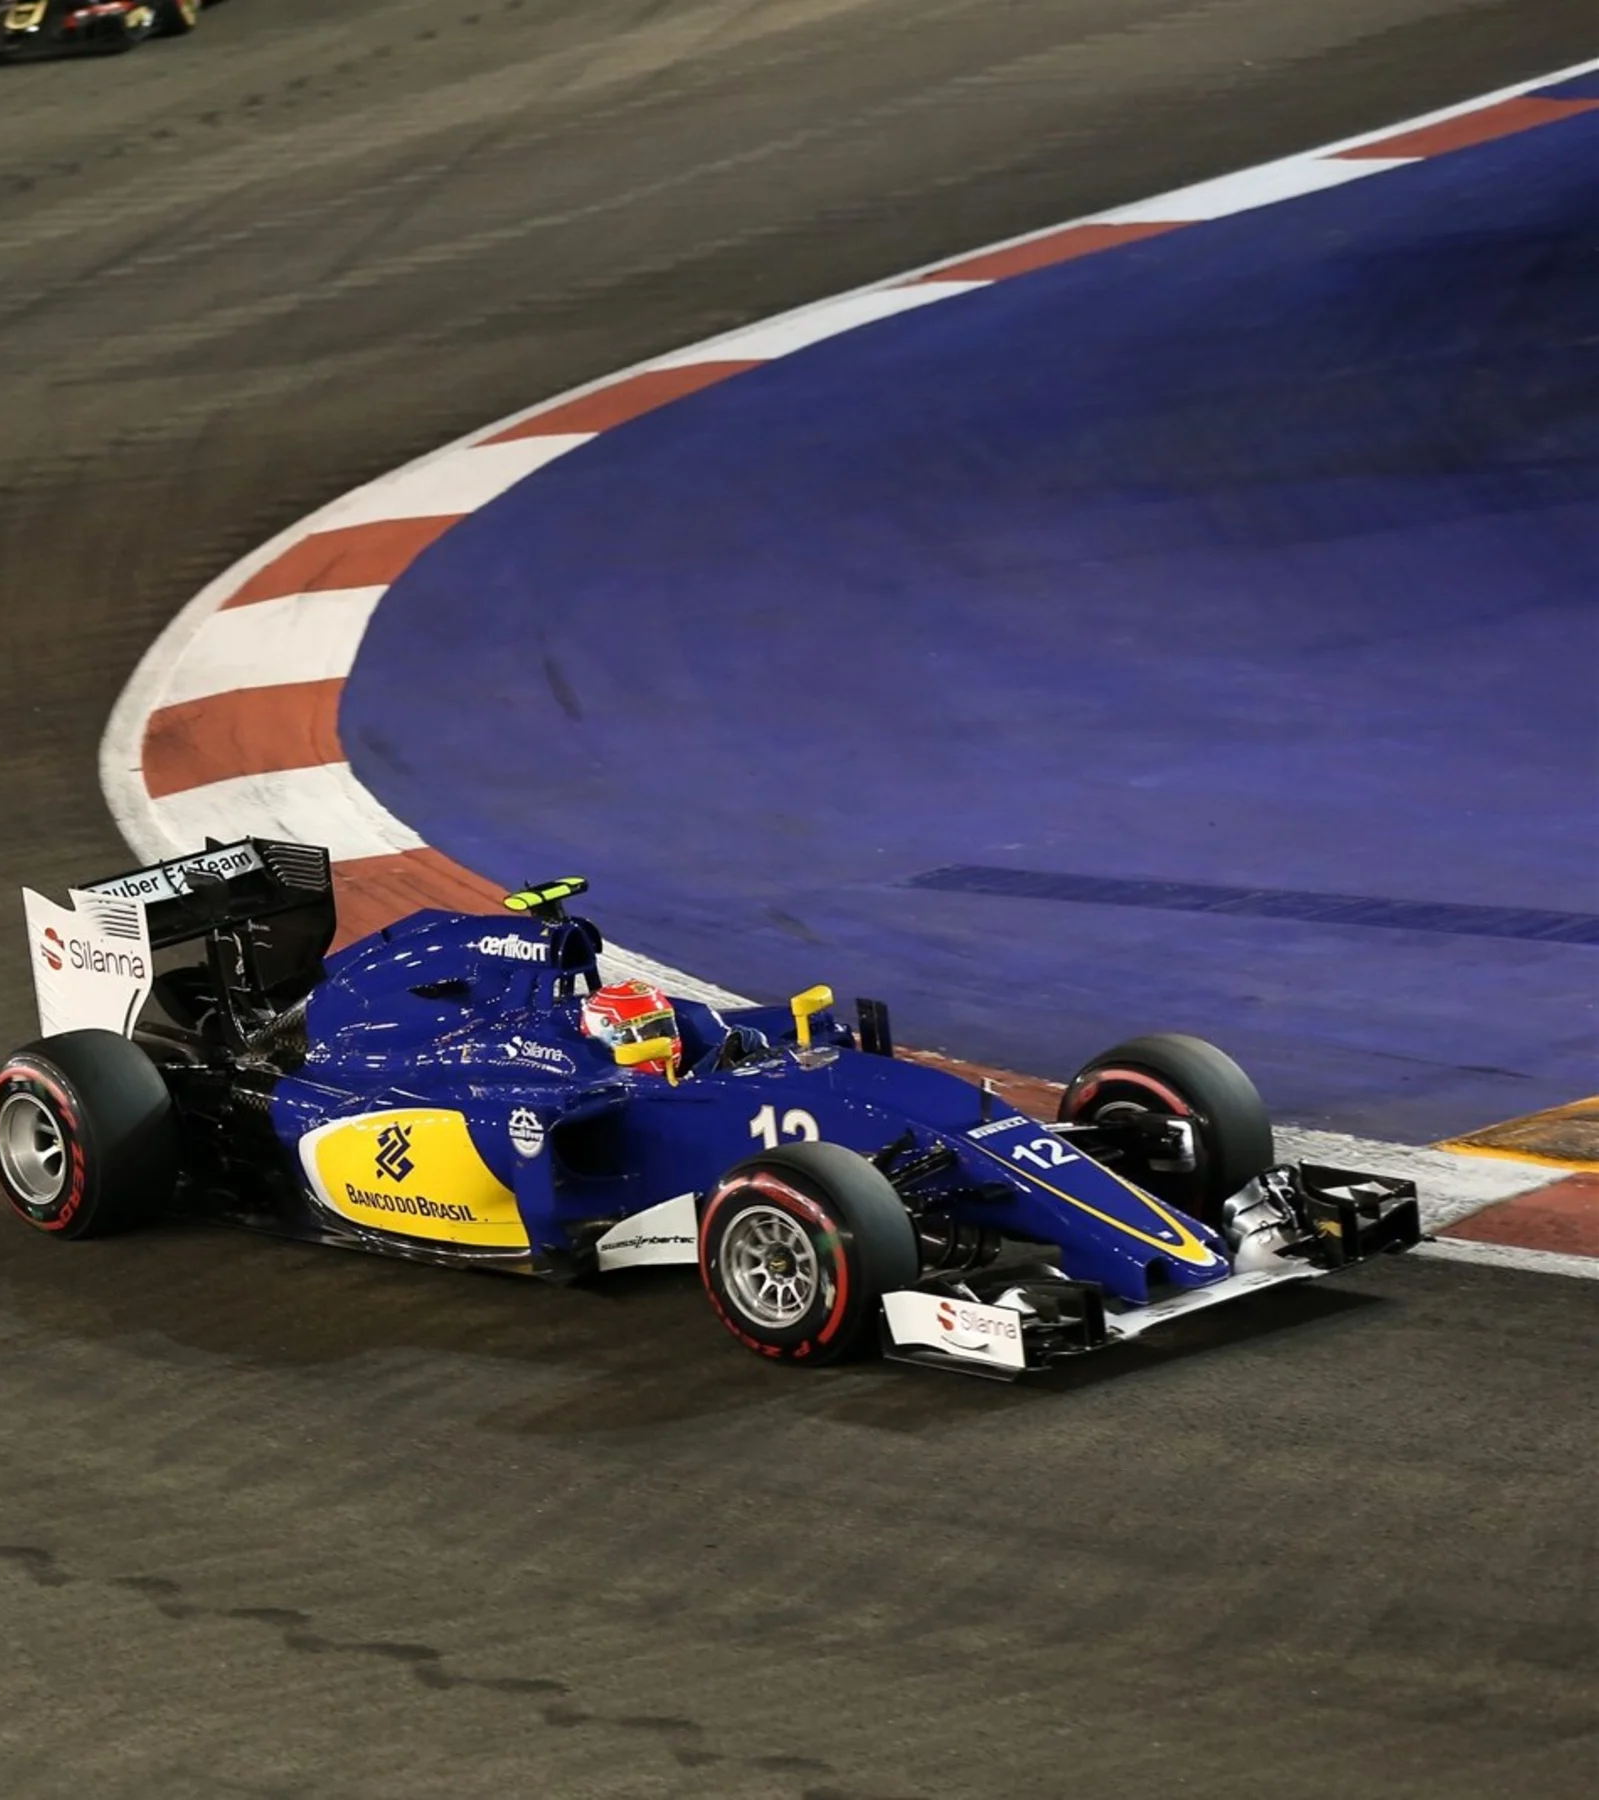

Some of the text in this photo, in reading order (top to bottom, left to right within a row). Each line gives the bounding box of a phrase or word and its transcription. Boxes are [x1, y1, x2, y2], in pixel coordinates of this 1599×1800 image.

[193, 850, 253, 873] Team
[69, 939, 146, 979] Silanna
[521, 1040, 563, 1061] Silanna
[1012, 1138, 1080, 1169] 12
[345, 1183, 477, 1222] BANCO DO BRASIL
[960, 1309, 1018, 1340] Silanna
